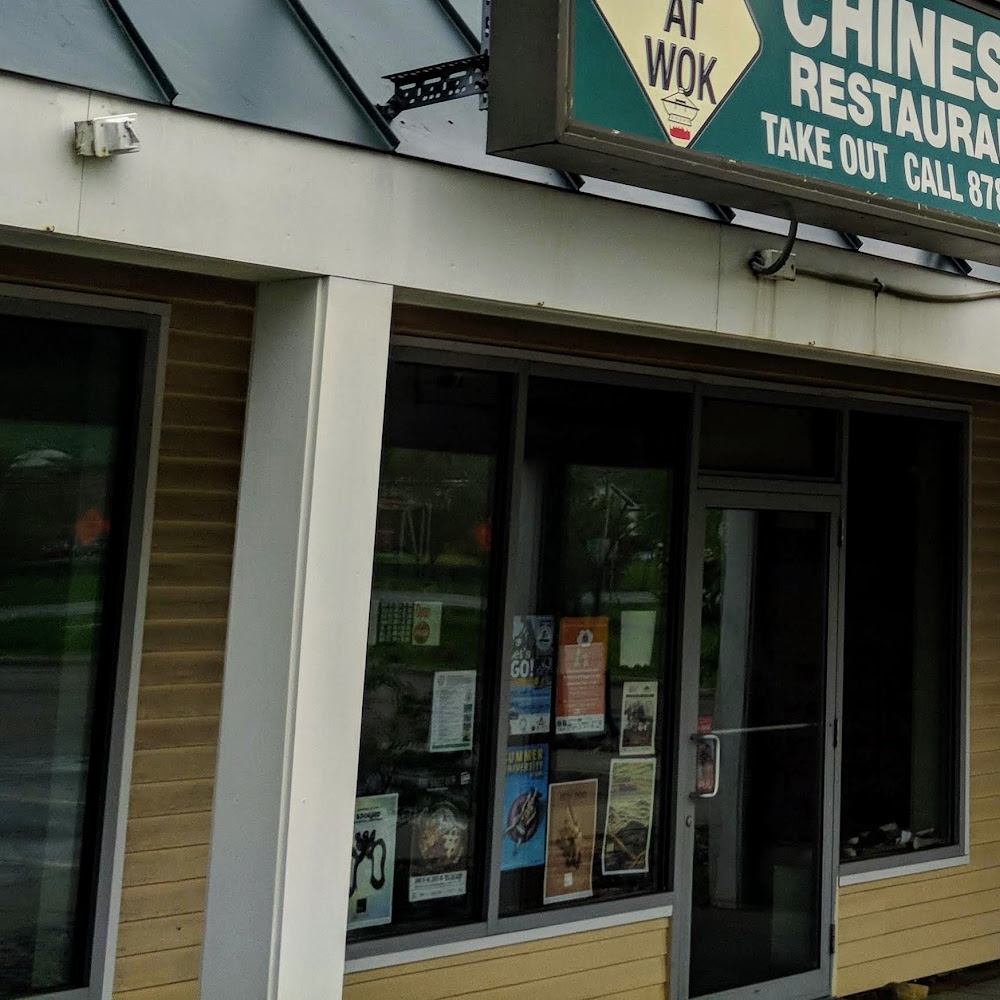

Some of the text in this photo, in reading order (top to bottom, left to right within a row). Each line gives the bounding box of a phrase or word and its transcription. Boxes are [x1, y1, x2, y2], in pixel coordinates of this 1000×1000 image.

[644, 34, 718, 105] WOK
[760, 111, 833, 170] TAKE
[839, 133, 889, 183] OUT
[903, 151, 965, 203] CALL
[510, 659, 535, 679] GO!
[506, 748, 544, 762] UMMER
